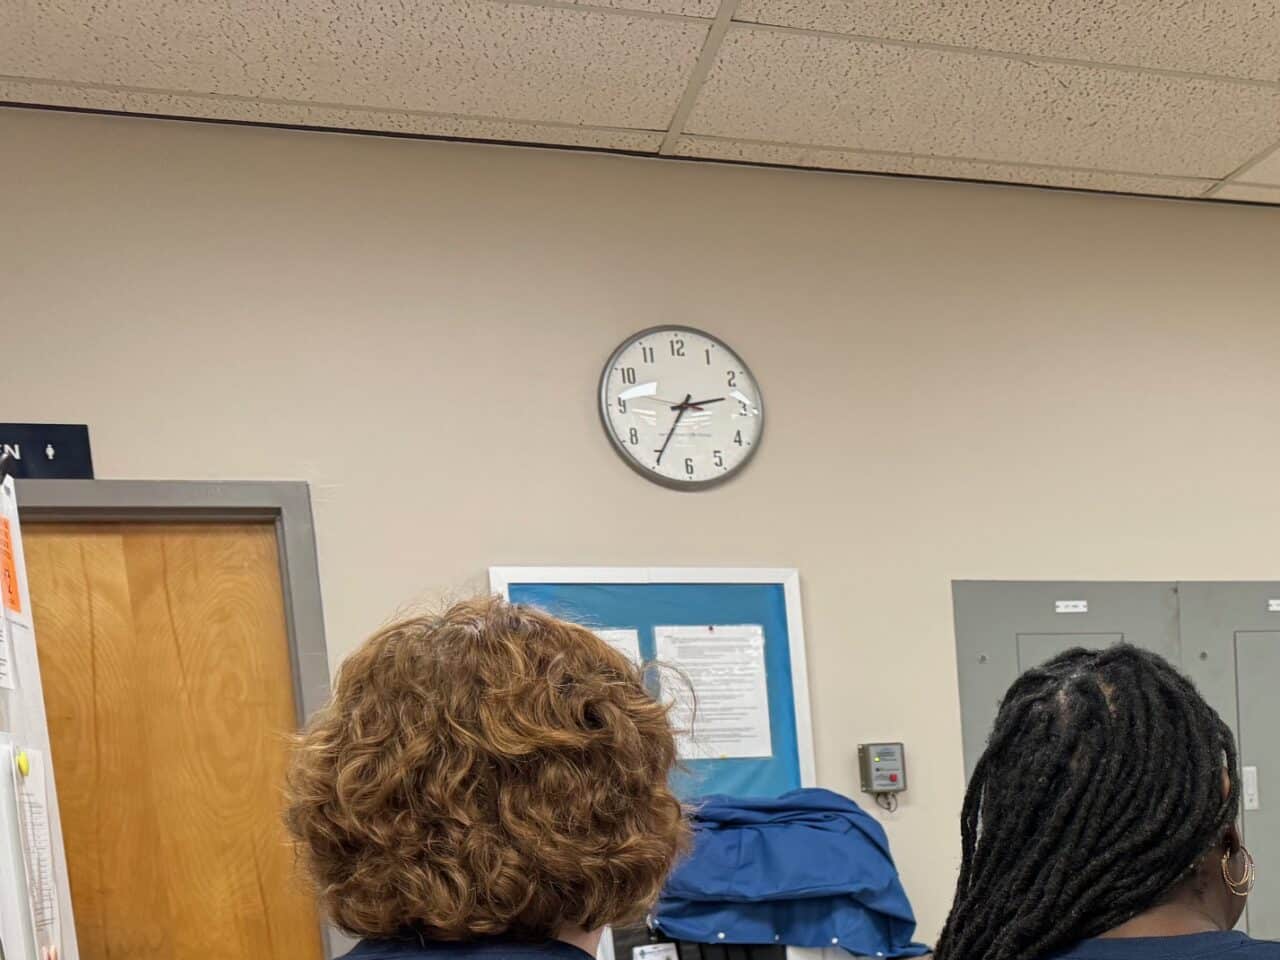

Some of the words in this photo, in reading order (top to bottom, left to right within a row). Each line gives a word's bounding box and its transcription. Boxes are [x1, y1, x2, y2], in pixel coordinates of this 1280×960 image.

[641, 346, 654, 363] 11
[669, 339, 685, 357] 12
[704, 348, 711, 365] 1
[620, 367, 636, 384] 10
[726, 370, 737, 387] 2
[617, 394, 627, 414] 9
[737, 400, 748, 416] 3
[629, 427, 639, 445] 8
[733, 429, 743, 446] 4
[684, 458, 694, 475] 6
[712, 450, 723, 467] 5
